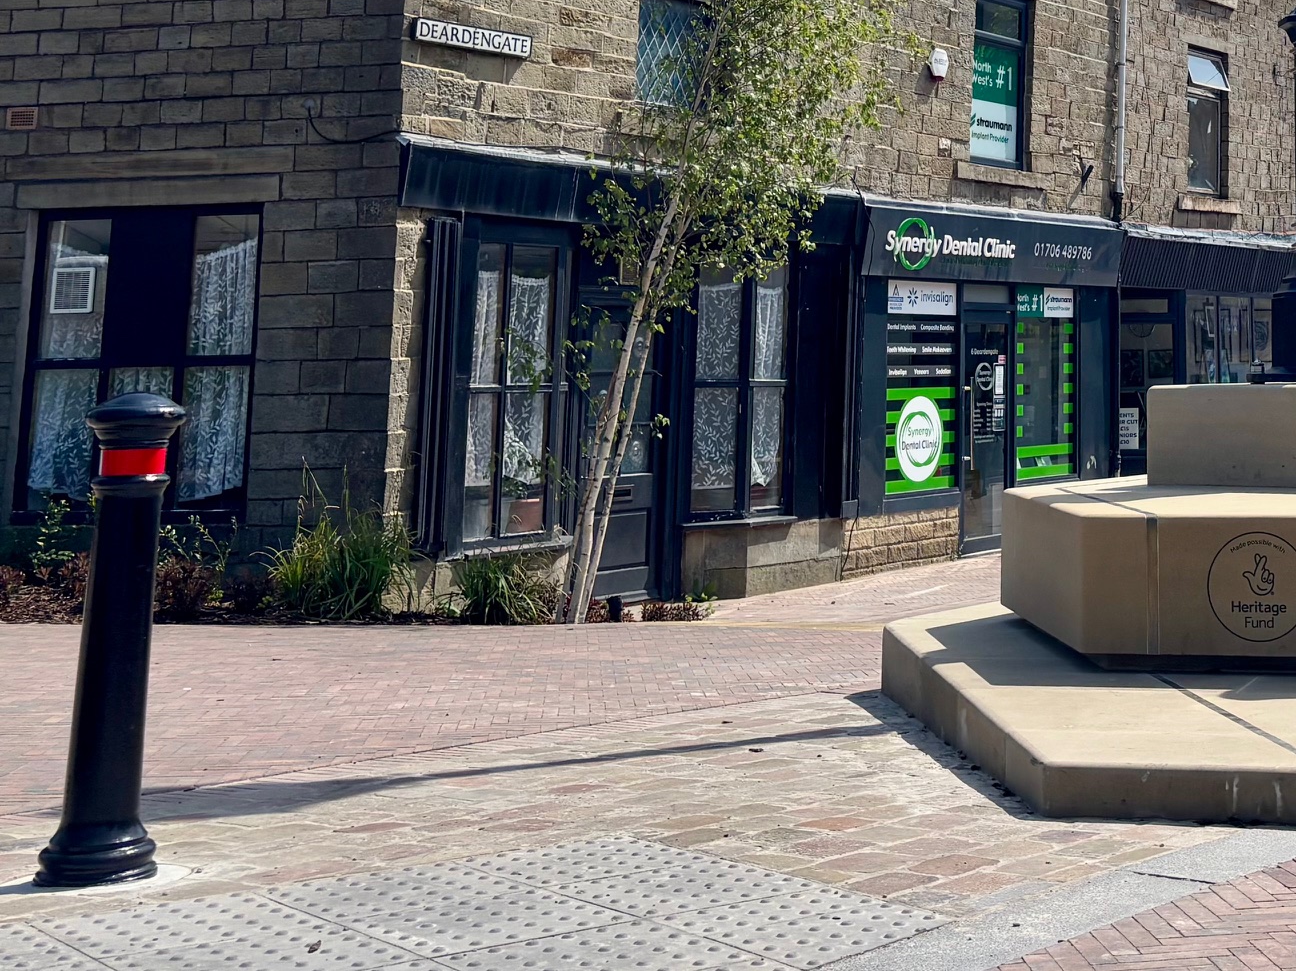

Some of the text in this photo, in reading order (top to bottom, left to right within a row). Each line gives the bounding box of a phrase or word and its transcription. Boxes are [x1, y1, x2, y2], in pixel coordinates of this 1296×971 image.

[419, 21, 528, 53] DEARDENGATE
[996, 65, 1012, 91] #1
[976, 117, 1013, 132] straumann
[989, 133, 1009, 143] Provider
[885, 230, 1093, 260] Synergy Dental Clinic 01706 489786
[920, 290, 954, 306] invisalign
[1031, 294, 1043, 312] #1
[907, 426, 932, 437] Synergy
[902, 439, 937, 450] Dental Clinic
[1230, 543, 1246, 553] Made
[1272, 544, 1286, 554] with
[1231, 600, 1287, 616] Heritage
[1244, 616, 1275, 628] Fund
